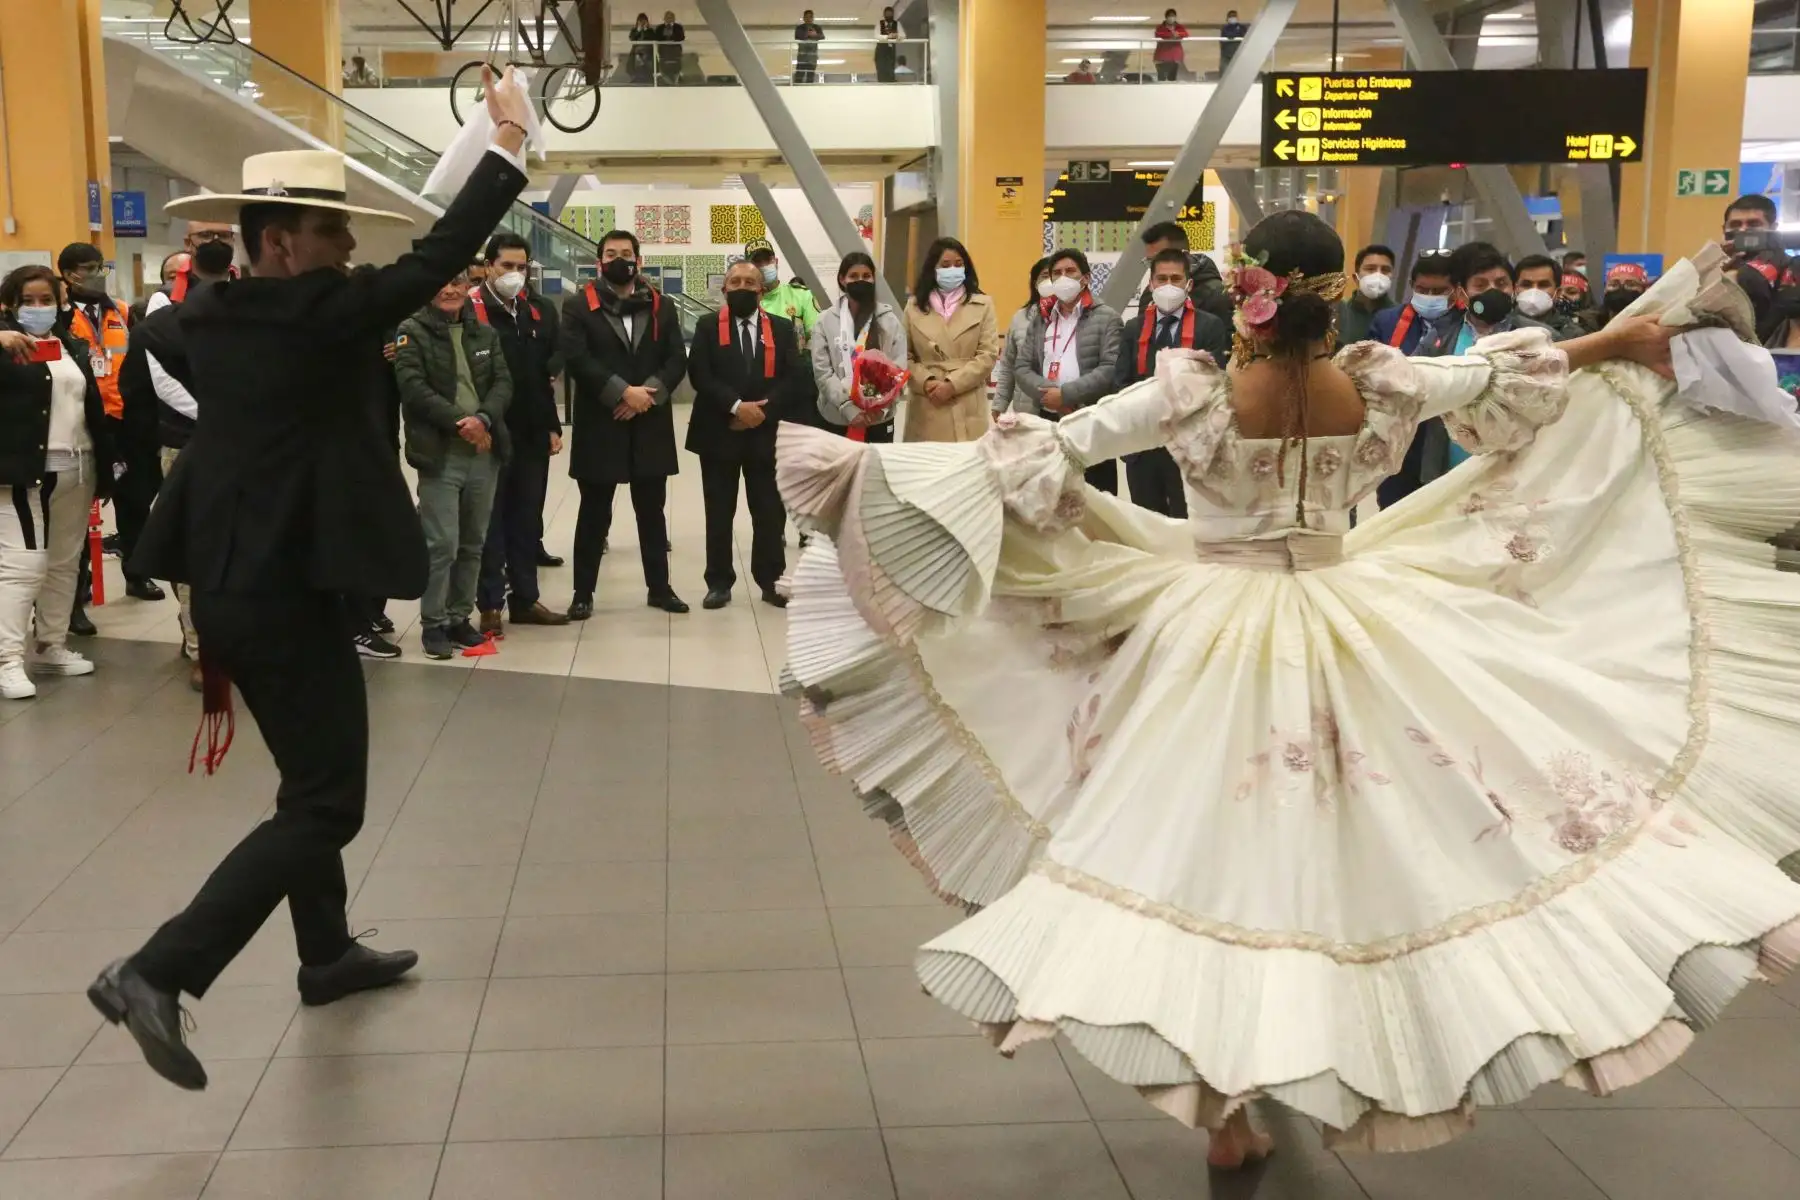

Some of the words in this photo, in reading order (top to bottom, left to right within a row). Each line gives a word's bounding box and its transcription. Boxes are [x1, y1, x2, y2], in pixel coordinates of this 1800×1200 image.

[1323, 77, 1355, 88] Puertas
[1356, 77, 1368, 88] de
[1369, 76, 1412, 90] Embarque
[1323, 91, 1358, 102] Departure
[1358, 90, 1379, 101] Gates
[1322, 107, 1372, 119] Información
[1321, 137, 1360, 149] Servicios
[1361, 137, 1407, 151] Higiénicos
[1566, 135, 1590, 147] Hotel
[1321, 151, 1359, 161] Restrooms
[1567, 149, 1589, 159] Hotel
